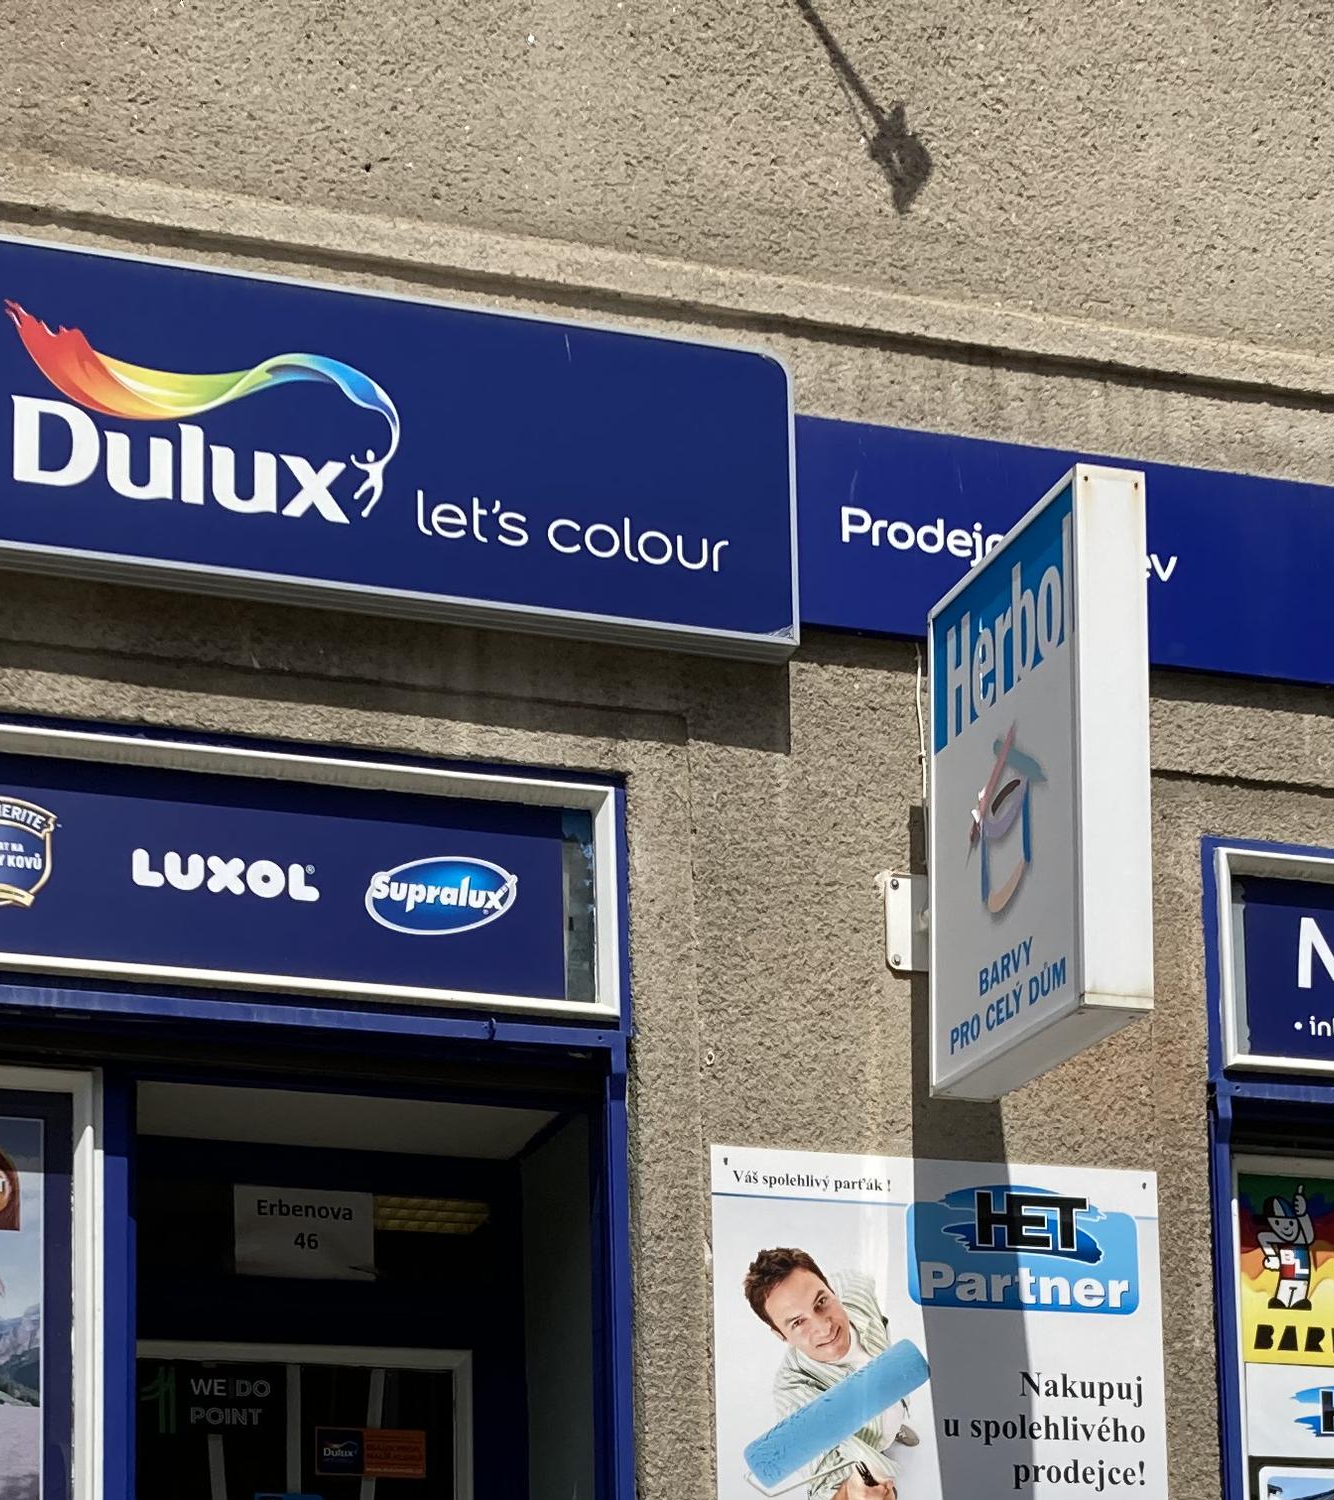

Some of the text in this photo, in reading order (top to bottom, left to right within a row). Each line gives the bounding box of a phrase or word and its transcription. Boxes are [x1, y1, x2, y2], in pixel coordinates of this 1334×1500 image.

[10, 394, 350, 525] Dulux
[415, 488, 729, 573] let's colour
[946, 511, 1072, 740] Herbol
[7, 853, 43, 870] KOVŮ
[10, 842, 24, 853] NA
[132, 848, 320, 902] LUXOL
[373, 870, 510, 913] Supralux
[978, 936, 1033, 998] BARVY
[950, 957, 1067, 1055] PRO CELÝ DŮM
[733, 1168, 759, 1184] Váš
[762, 1172, 830, 1192] spolehlivý
[255, 1199, 354, 1222] Erbenova
[975, 1191, 1088, 1252] HET
[293, 1232, 319, 1250] 46
[921, 1261, 1131, 1309] Partner
[191, 1378, 271, 1398] WE DO
[1019, 1371, 1143, 1408] Nakupuj
[190, 1406, 263, 1426] POINT
[943, 1413, 1146, 1446] u spolehlivého
[323, 1447, 355, 1458] Dulux
[1013, 1459, 1146, 1493] prodejce!
